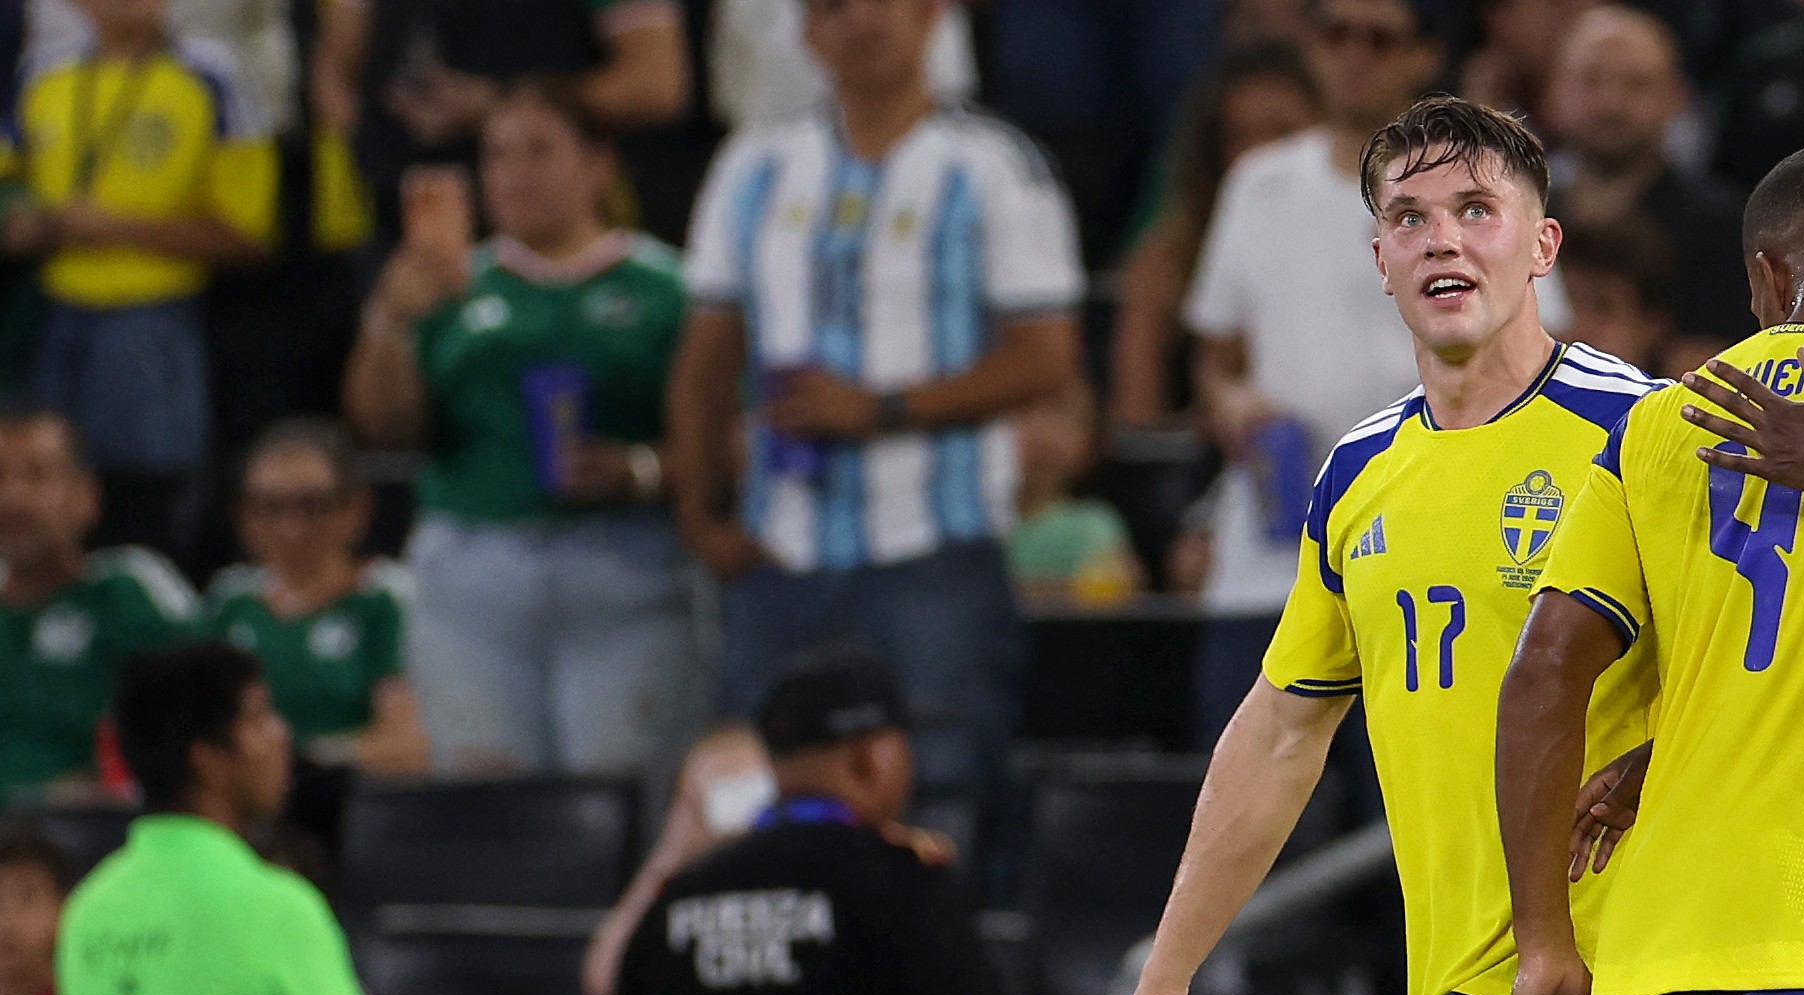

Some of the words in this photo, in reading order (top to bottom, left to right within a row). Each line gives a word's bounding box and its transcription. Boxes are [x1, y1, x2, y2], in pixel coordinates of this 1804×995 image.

[1512, 496, 1554, 506] SVERIGE
[1708, 440, 1802, 672] 4
[1396, 585, 1466, 692] 17
